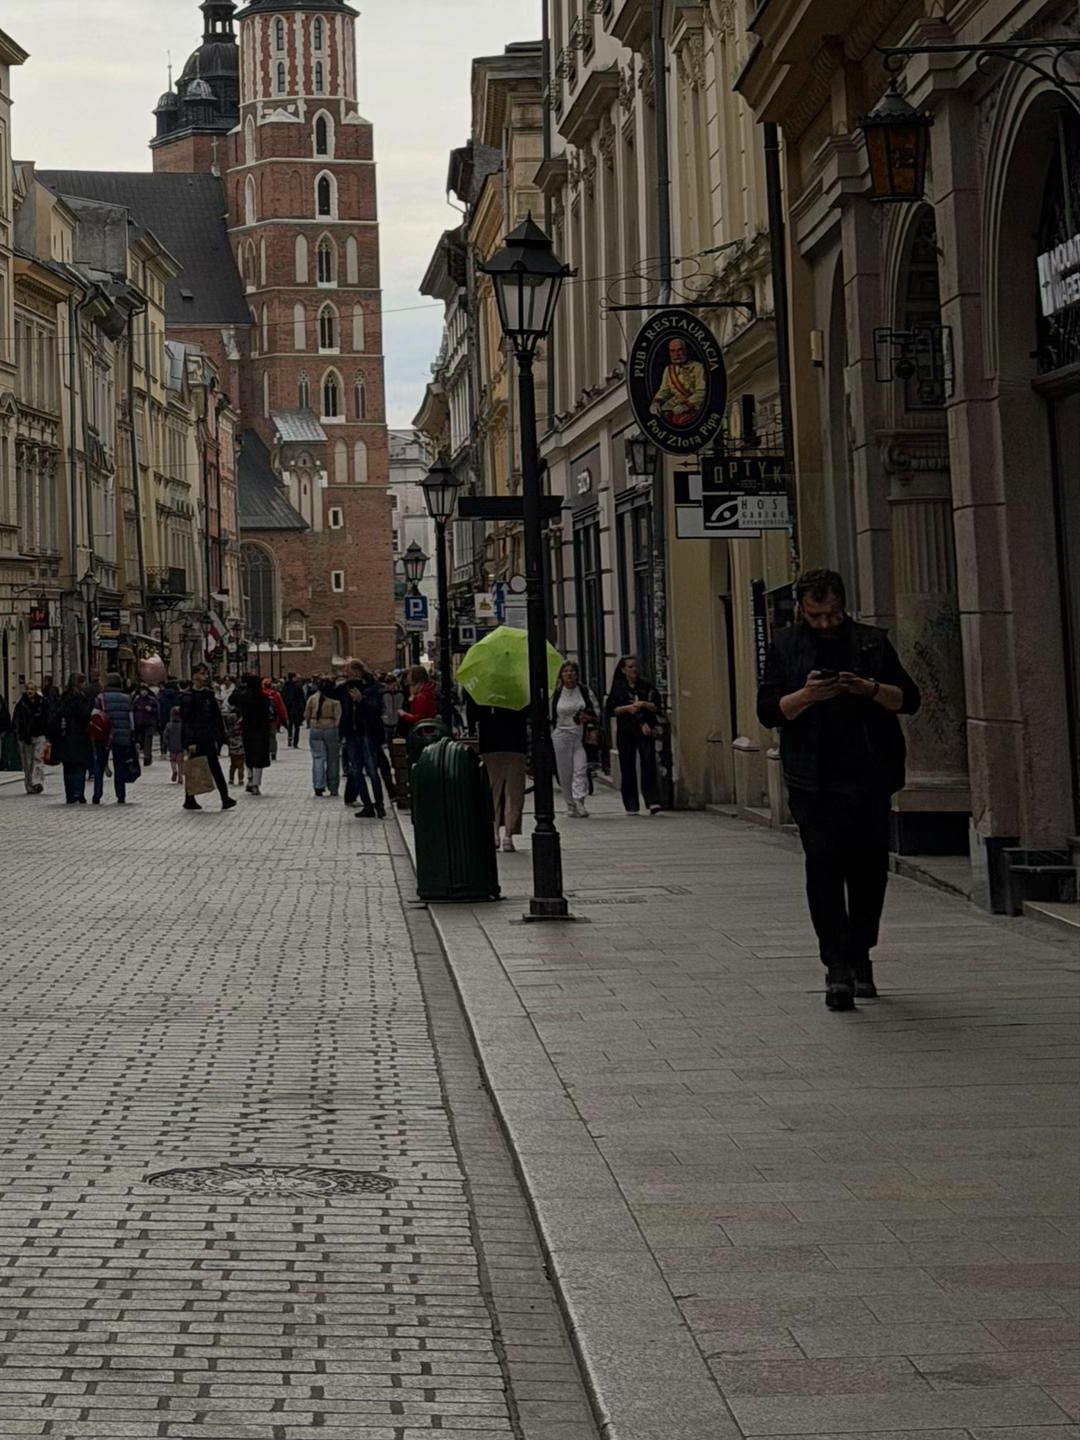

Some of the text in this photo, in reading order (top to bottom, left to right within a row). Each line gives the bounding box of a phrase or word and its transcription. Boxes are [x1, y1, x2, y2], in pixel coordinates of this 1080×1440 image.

[634, 316, 720, 378] PUB RESTAURACJA
[647, 418, 666, 439] Pod
[713, 459, 782, 484] OPTYK
[409, 598, 424, 617] P
